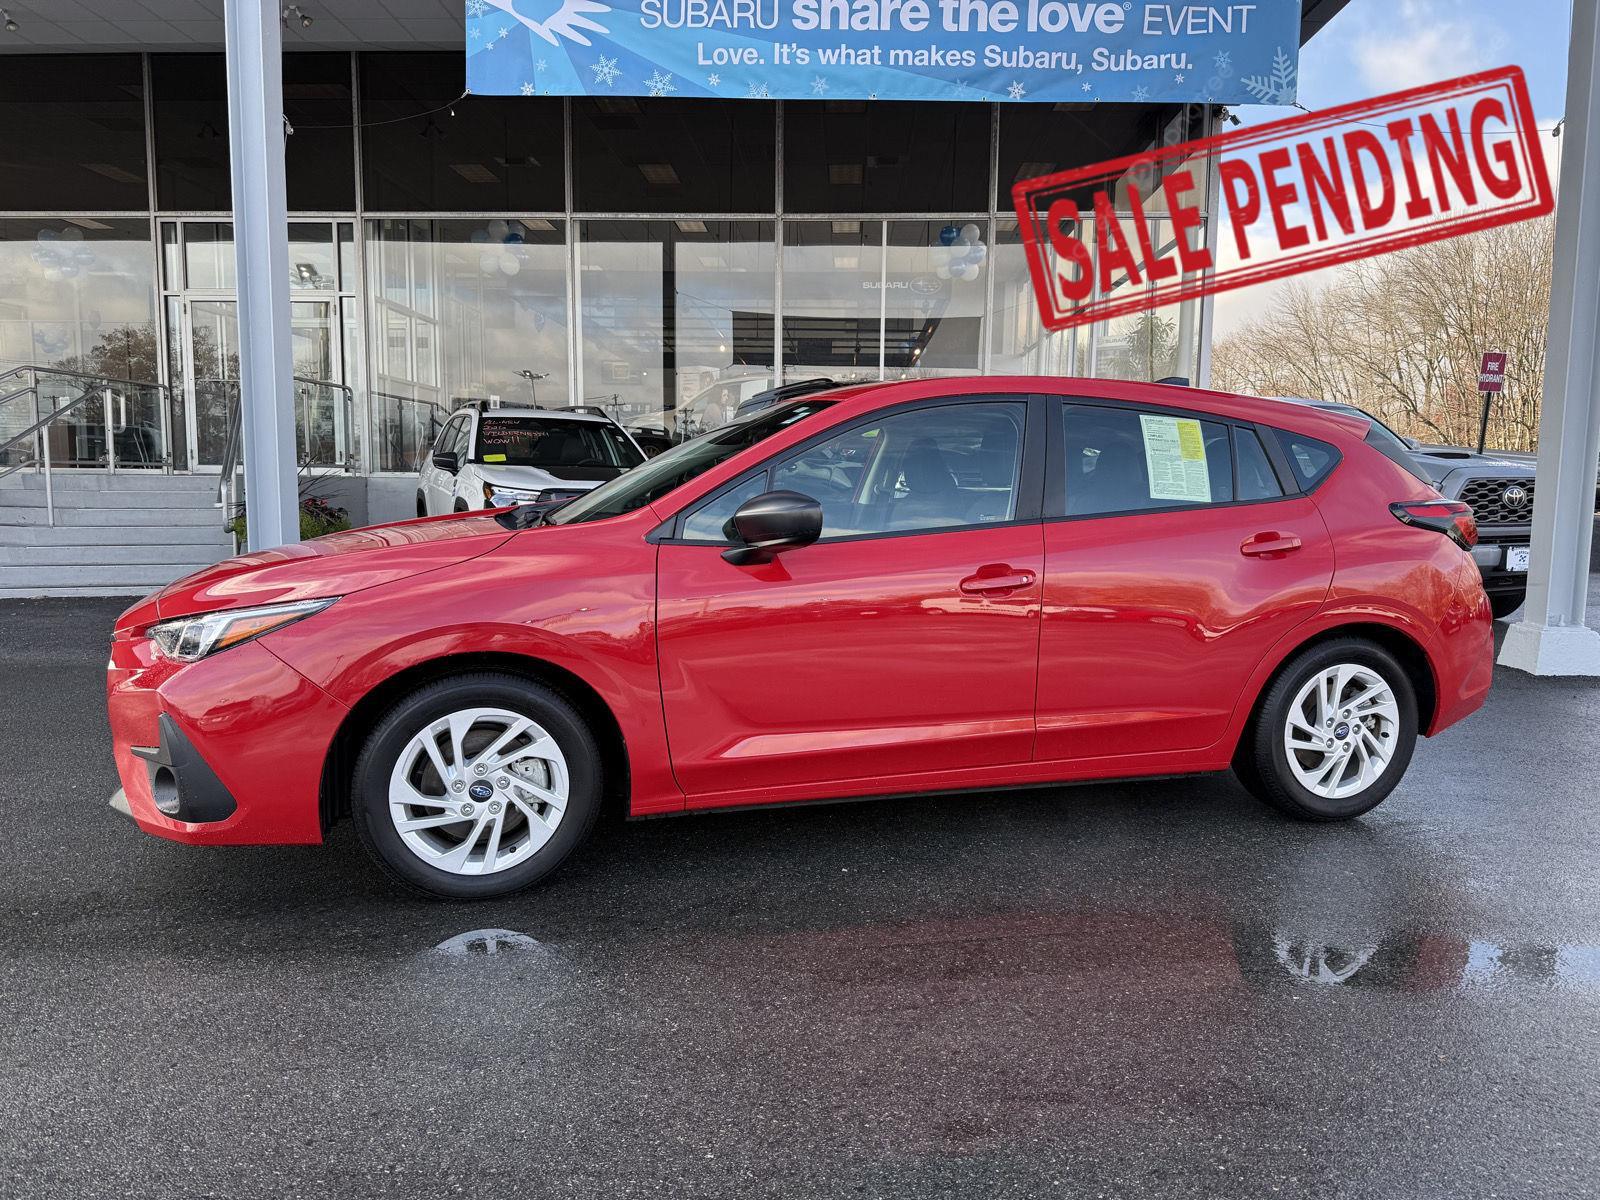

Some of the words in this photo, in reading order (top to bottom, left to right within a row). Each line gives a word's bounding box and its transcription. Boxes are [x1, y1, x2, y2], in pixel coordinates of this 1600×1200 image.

[640, 0, 779, 30] SUBARU
[792, 0, 930, 32] share
[939, 0, 1019, 33] the
[1143, 4, 1257, 36] EVENT
[697, 42, 765, 66] Love.
[774, 42, 810, 65] It’s
[817, 43, 882, 66] what
[889, 45, 976, 67] makes
[983, 44, 1083, 75] Subaru,
[1091, 47, 1193, 72] Subaru.
